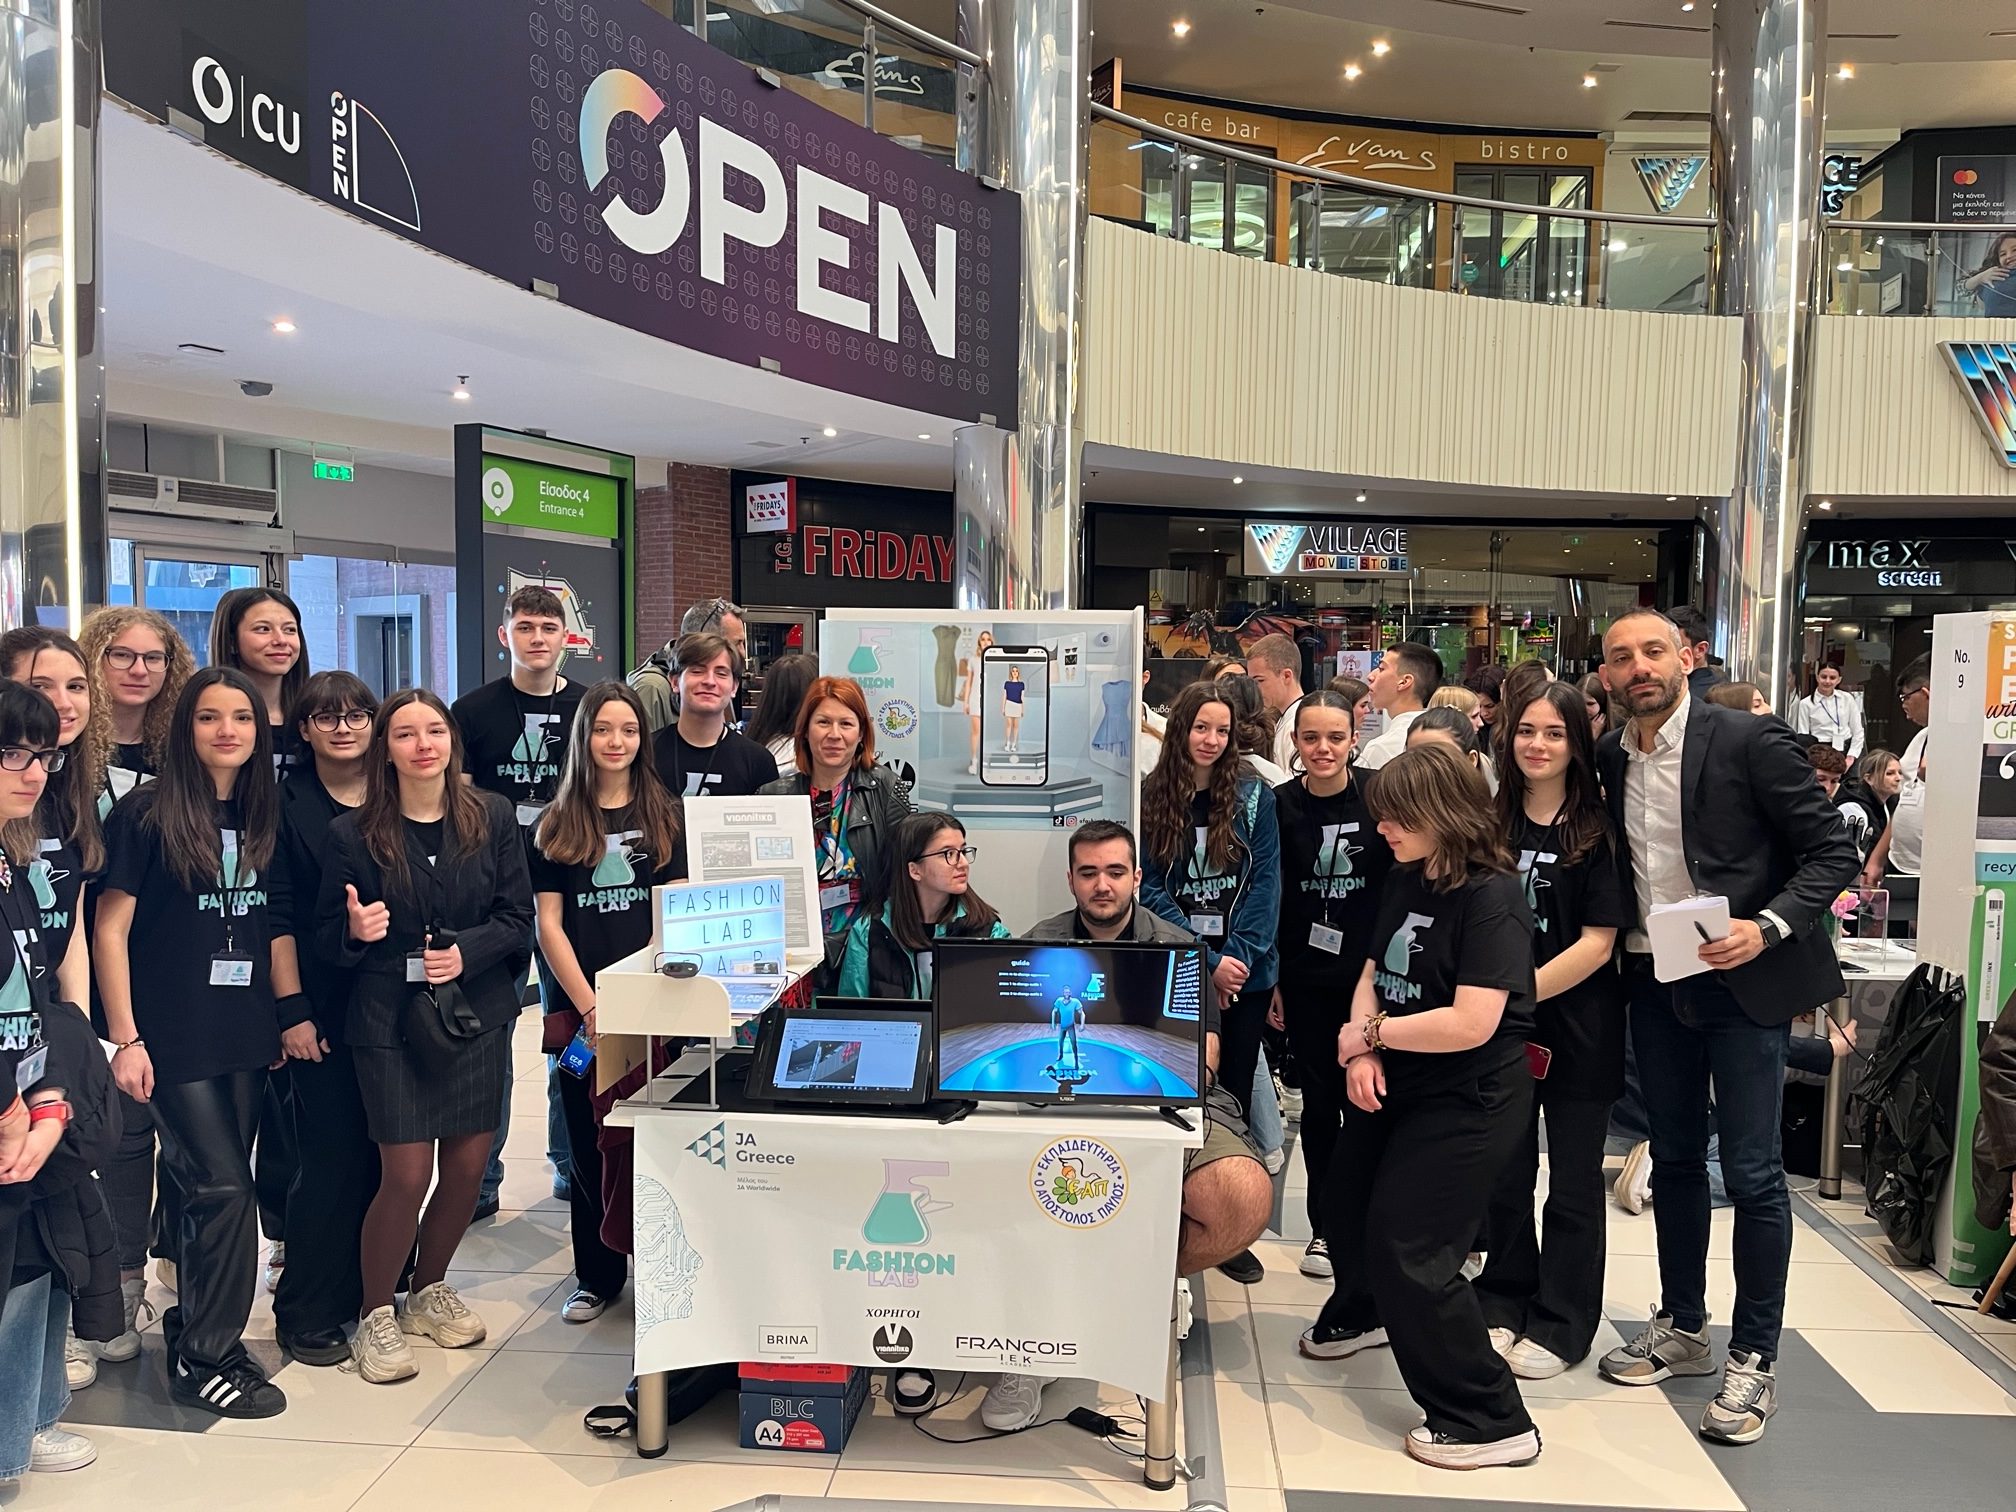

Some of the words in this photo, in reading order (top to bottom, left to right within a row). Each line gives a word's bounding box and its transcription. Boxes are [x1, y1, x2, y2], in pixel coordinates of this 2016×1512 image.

[251, 93, 300, 154] CU
[1164, 111, 1212, 132] cafe
[1225, 116, 1261, 139] bar
[330, 91, 349, 200] OPEN
[1481, 140, 1569, 160] bistro
[579, 68, 957, 360] OPEN
[539, 480, 581, 503] Είσοδος
[583, 489, 590, 503] 4
[539, 501, 577, 517] Entrance
[579, 508, 585, 518] 4
[1308, 526, 1408, 554] VILLAGE
[1304, 556, 1356, 570] MOVIE
[1359, 556, 1408, 571] STORE
[1828, 540, 1931, 568] max
[1878, 571, 1942, 586] screen
[1954, 649, 1971, 664] No.
[1958, 674, 1964, 688] 9
[1181, 875, 1237, 896] ASHION
[577, 887, 649, 908] FASHION
[598, 900, 631, 913] LAB
[668, 884, 780, 915] FASHION
[703, 919, 752, 945] LAB
[736, 1132, 757, 1147] JA
[736, 1149, 795, 1165] Greece
[1037, 1139, 1121, 1174] ΕΚΠΑΙΔΕΥΤΗΡΙΑ
[1036, 1189, 1097, 1225] ΑΠΟΣΤΟΛΟΣ
[1097, 1182, 1125, 1219] ΠΑΥΛΟΣ
[832, 1248, 955, 1276] FASHION
[867, 1267, 920, 1288] LAB
[866, 1308, 920, 1319] ΧΟΡΗΓΟΙ
[767, 1334, 809, 1345] BRINA
[955, 1336, 1077, 1356] FRANCOIS
[770, 1398, 814, 1418] BLC
[758, 1427, 783, 1442] A4
